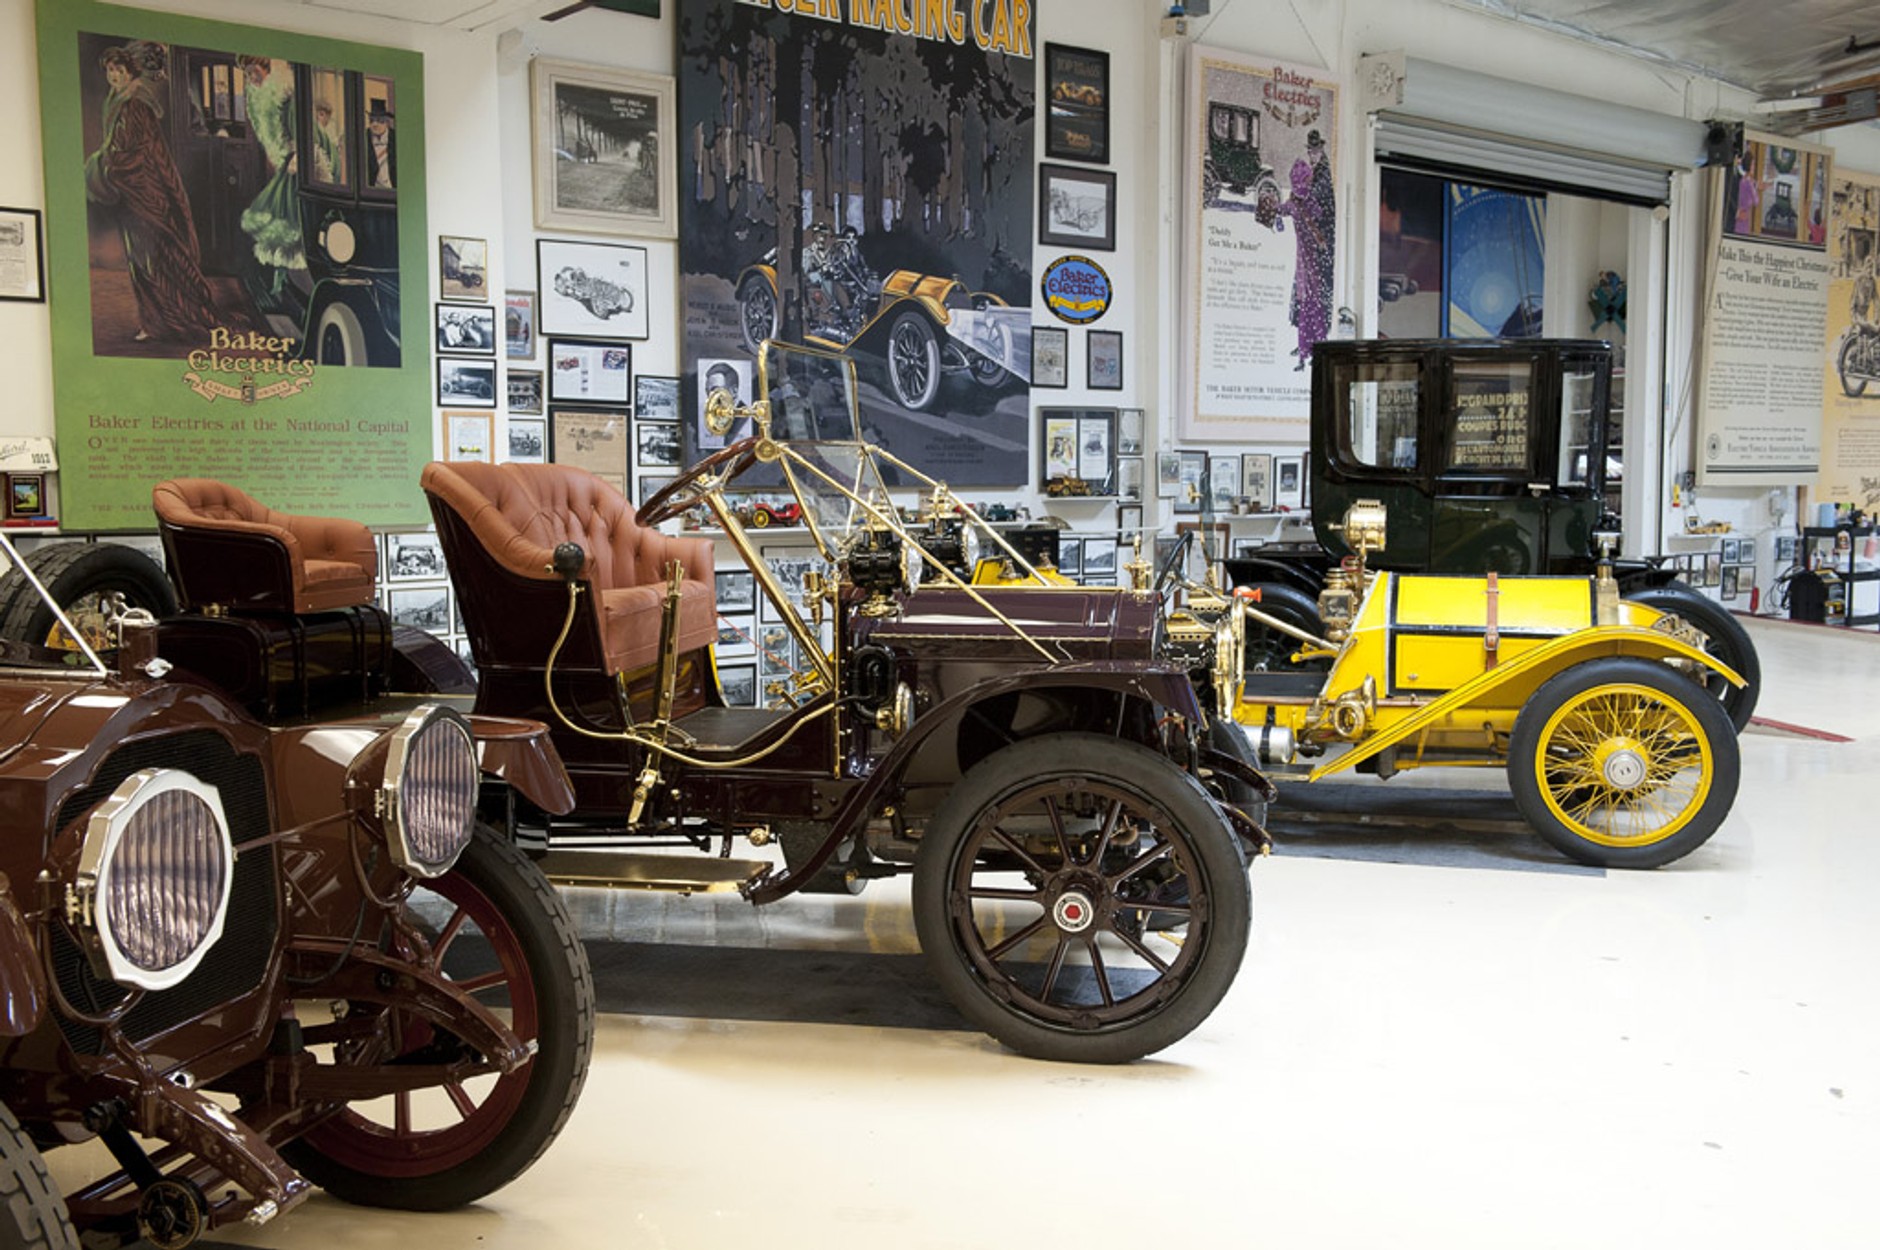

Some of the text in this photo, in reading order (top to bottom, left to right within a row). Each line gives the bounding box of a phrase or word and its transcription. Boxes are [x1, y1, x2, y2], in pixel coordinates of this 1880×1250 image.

[974, 0, 1032, 58] CAR
[1273, 67, 1314, 89] Baker
[1263, 80, 1321, 109] Electrics
[1738, 247, 1753, 261] This
[1753, 251, 1764, 265] the
[1765, 252, 1795, 270] Happiest
[1061, 267, 1099, 284] Baker
[1745, 269, 1762, 284] Your
[1762, 271, 1780, 287] Wife
[1782, 278, 1791, 288] an
[1792, 276, 1819, 291] Electric
[1048, 277, 1106, 297] Electrics
[210, 326, 296, 354] Baker
[187, 349, 316, 377] Electrics
[1469, 393, 1504, 407] GRAND
[88, 415, 409, 435] Baker Electrics at the National Capital
[1458, 420, 1498, 432] COUPES
